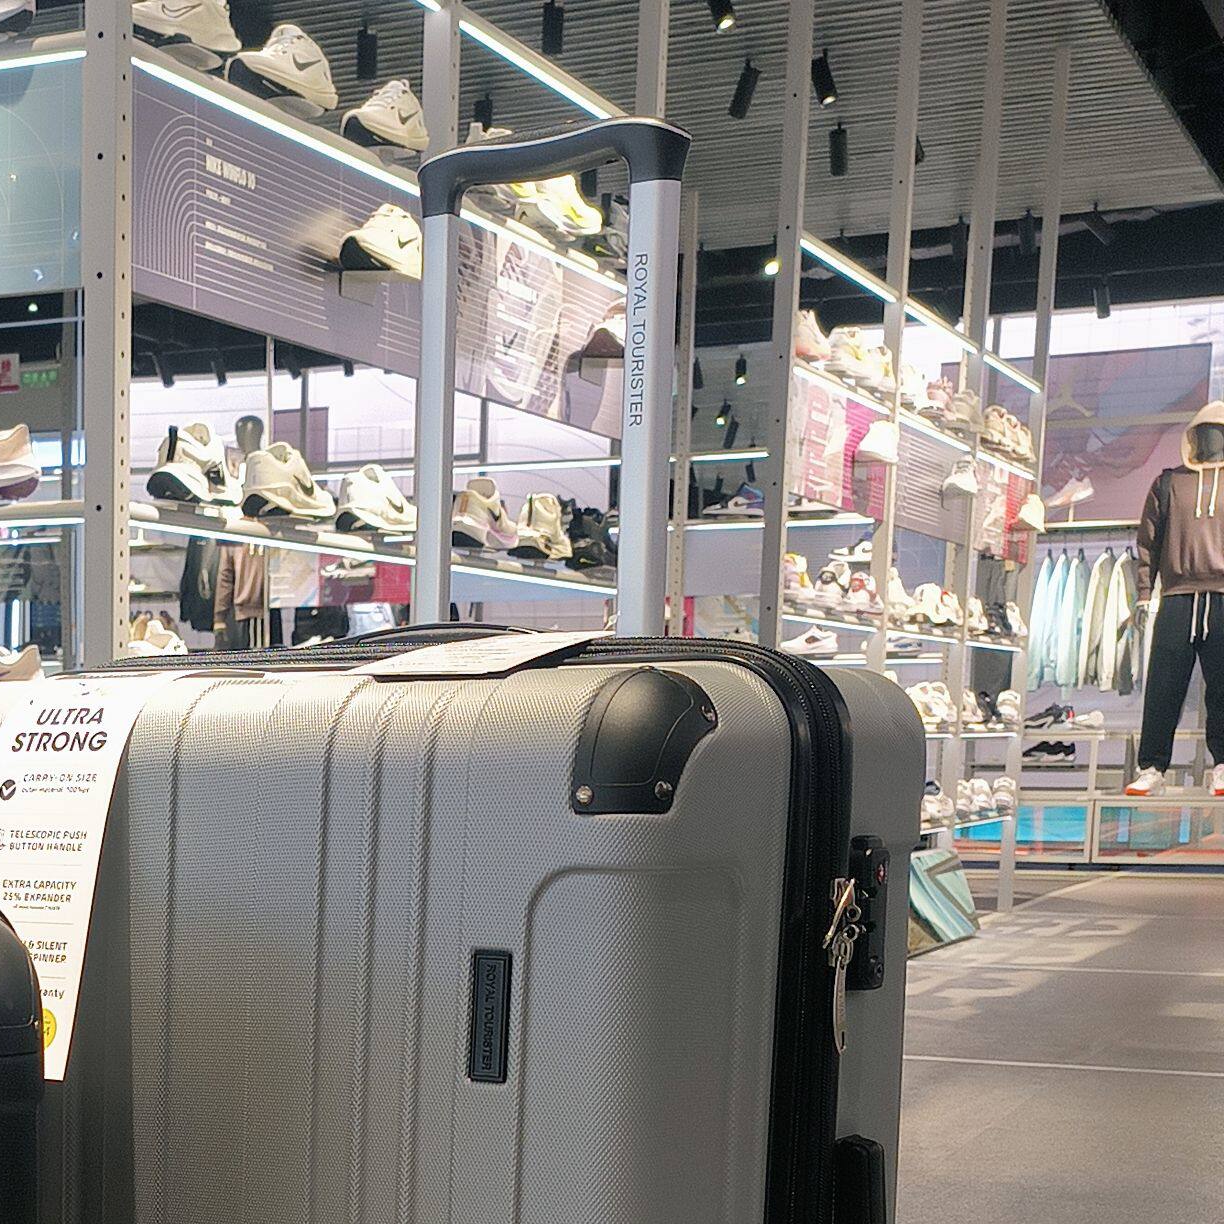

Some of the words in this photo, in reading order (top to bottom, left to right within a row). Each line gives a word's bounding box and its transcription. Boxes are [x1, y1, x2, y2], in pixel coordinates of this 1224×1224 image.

[633, 253, 648, 316] ROYAL
[629, 320, 646, 427] TOURISTER
[36, 707, 104, 725] ULTRA
[11, 731, 108, 752] STRONG
[75, 773, 97, 783] SIZE
[10, 830, 61, 840] TELESCOPIC
[63, 830, 87, 840] PUSH
[9, 842, 44, 850] BUTTON
[47, 842, 83, 852] HANDLE
[2, 880, 31, 888] EXTRA
[33, 880, 77, 890] CAPACITY
[3, 892, 21, 901] 25%
[24, 892, 71, 903] EXPANDER
[36, 940, 68, 951] SILENT
[485, 963, 496, 1003] ROYAL
[482, 1005, 495, 1071] TOURISTER
